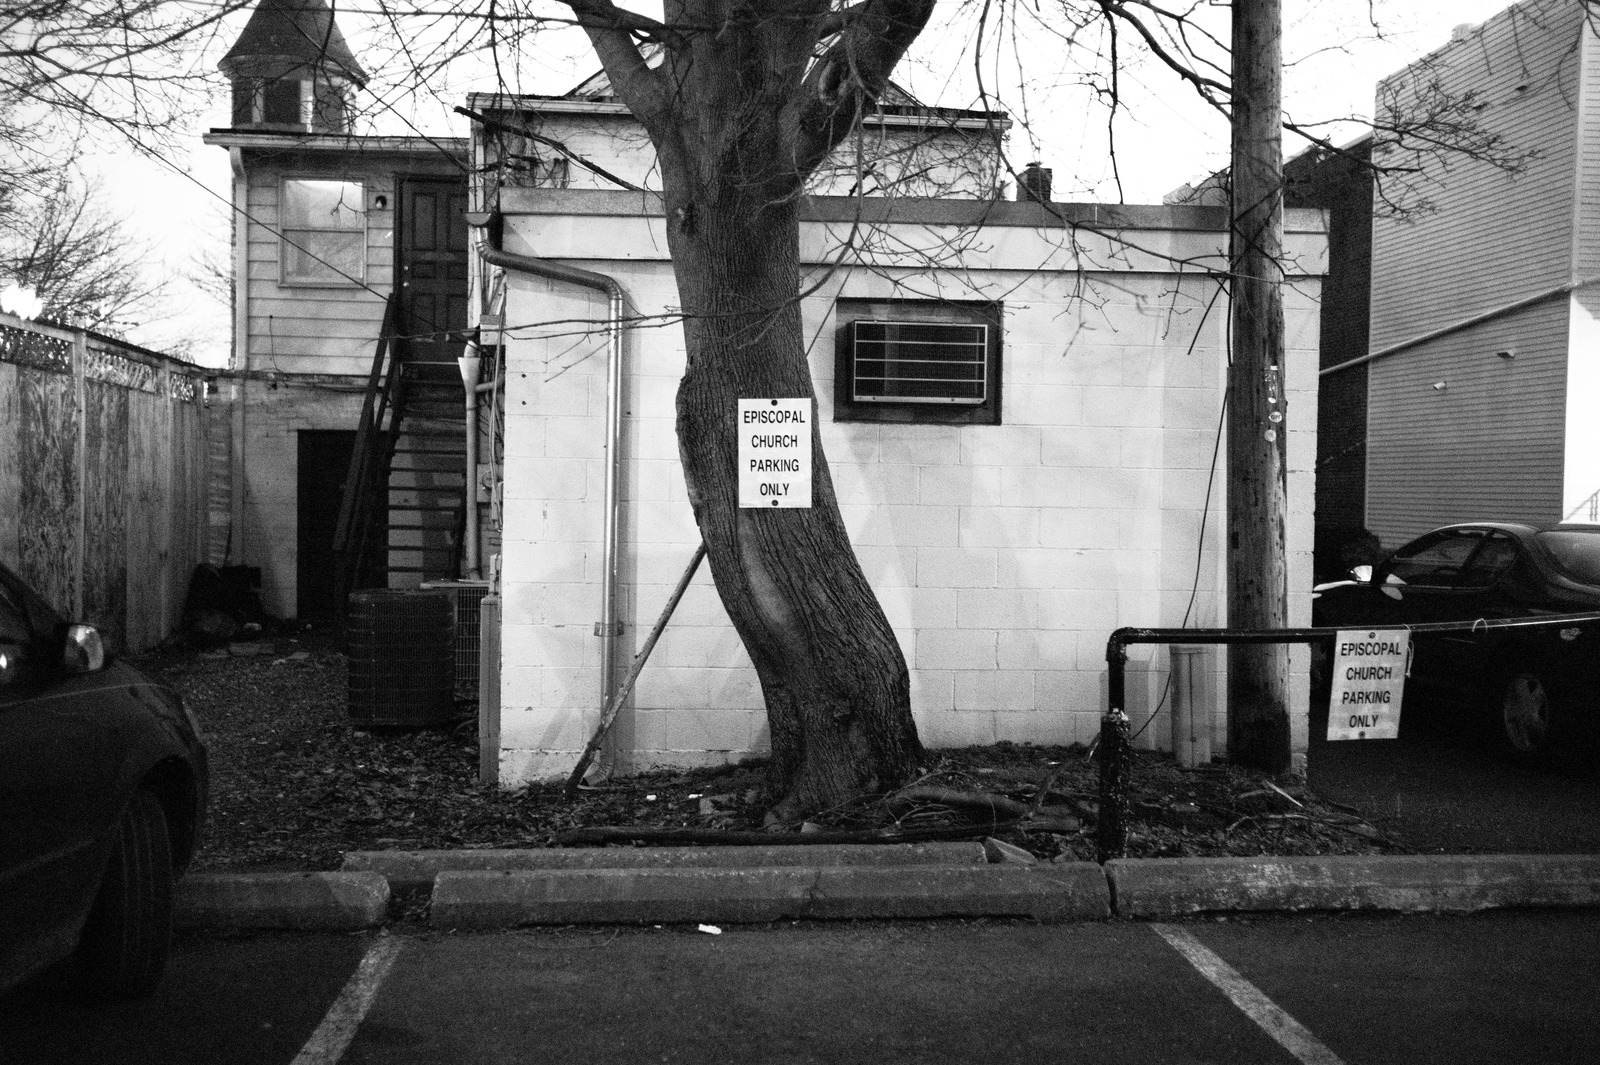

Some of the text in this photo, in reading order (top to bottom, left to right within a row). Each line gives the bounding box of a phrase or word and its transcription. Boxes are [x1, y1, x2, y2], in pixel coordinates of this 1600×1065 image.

[744, 410, 806, 424] EPISCOPAL
[751, 435, 798, 448] CHURCH
[750, 459, 799, 472] PARKING
[760, 483, 789, 496] ONLY
[1341, 642, 1402, 656] EPISCOPAL
[1346, 667, 1392, 680] CHURCH
[1342, 691, 1391, 704] PARKING
[1349, 715, 1379, 728] ONLY
